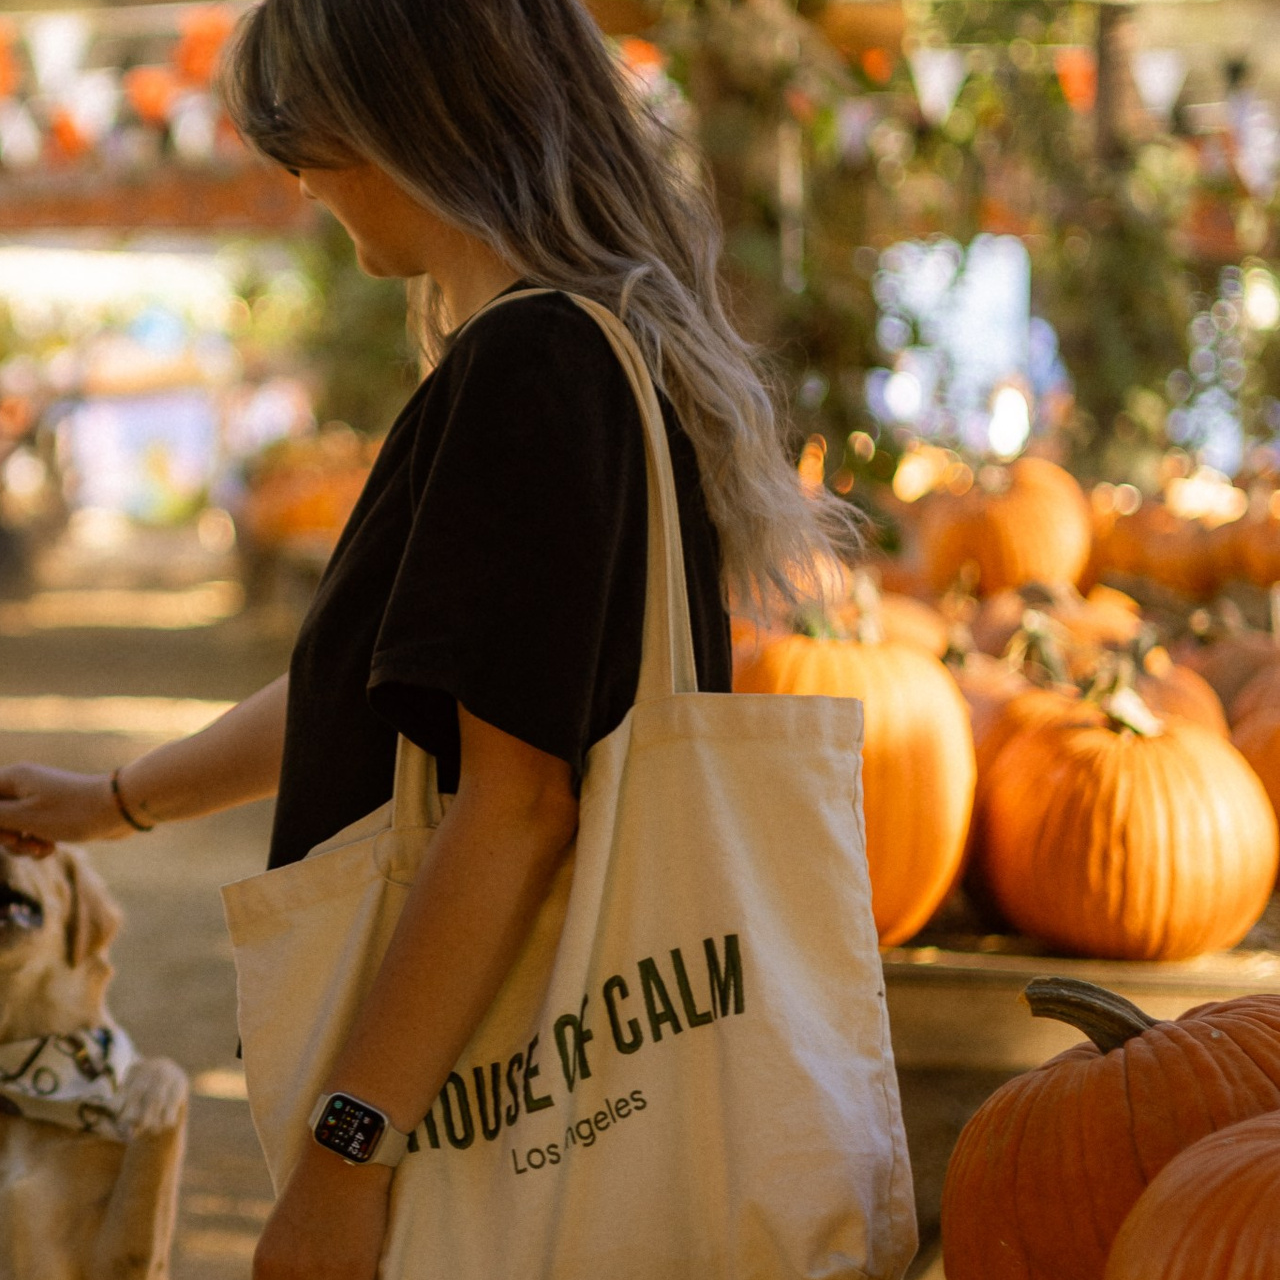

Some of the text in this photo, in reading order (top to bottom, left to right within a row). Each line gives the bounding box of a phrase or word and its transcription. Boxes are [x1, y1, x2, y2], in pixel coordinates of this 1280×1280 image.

[553, 993, 593, 1094] OF
[602, 933, 745, 1055] CALM
[511, 1089, 648, 1175] Los ngeles
